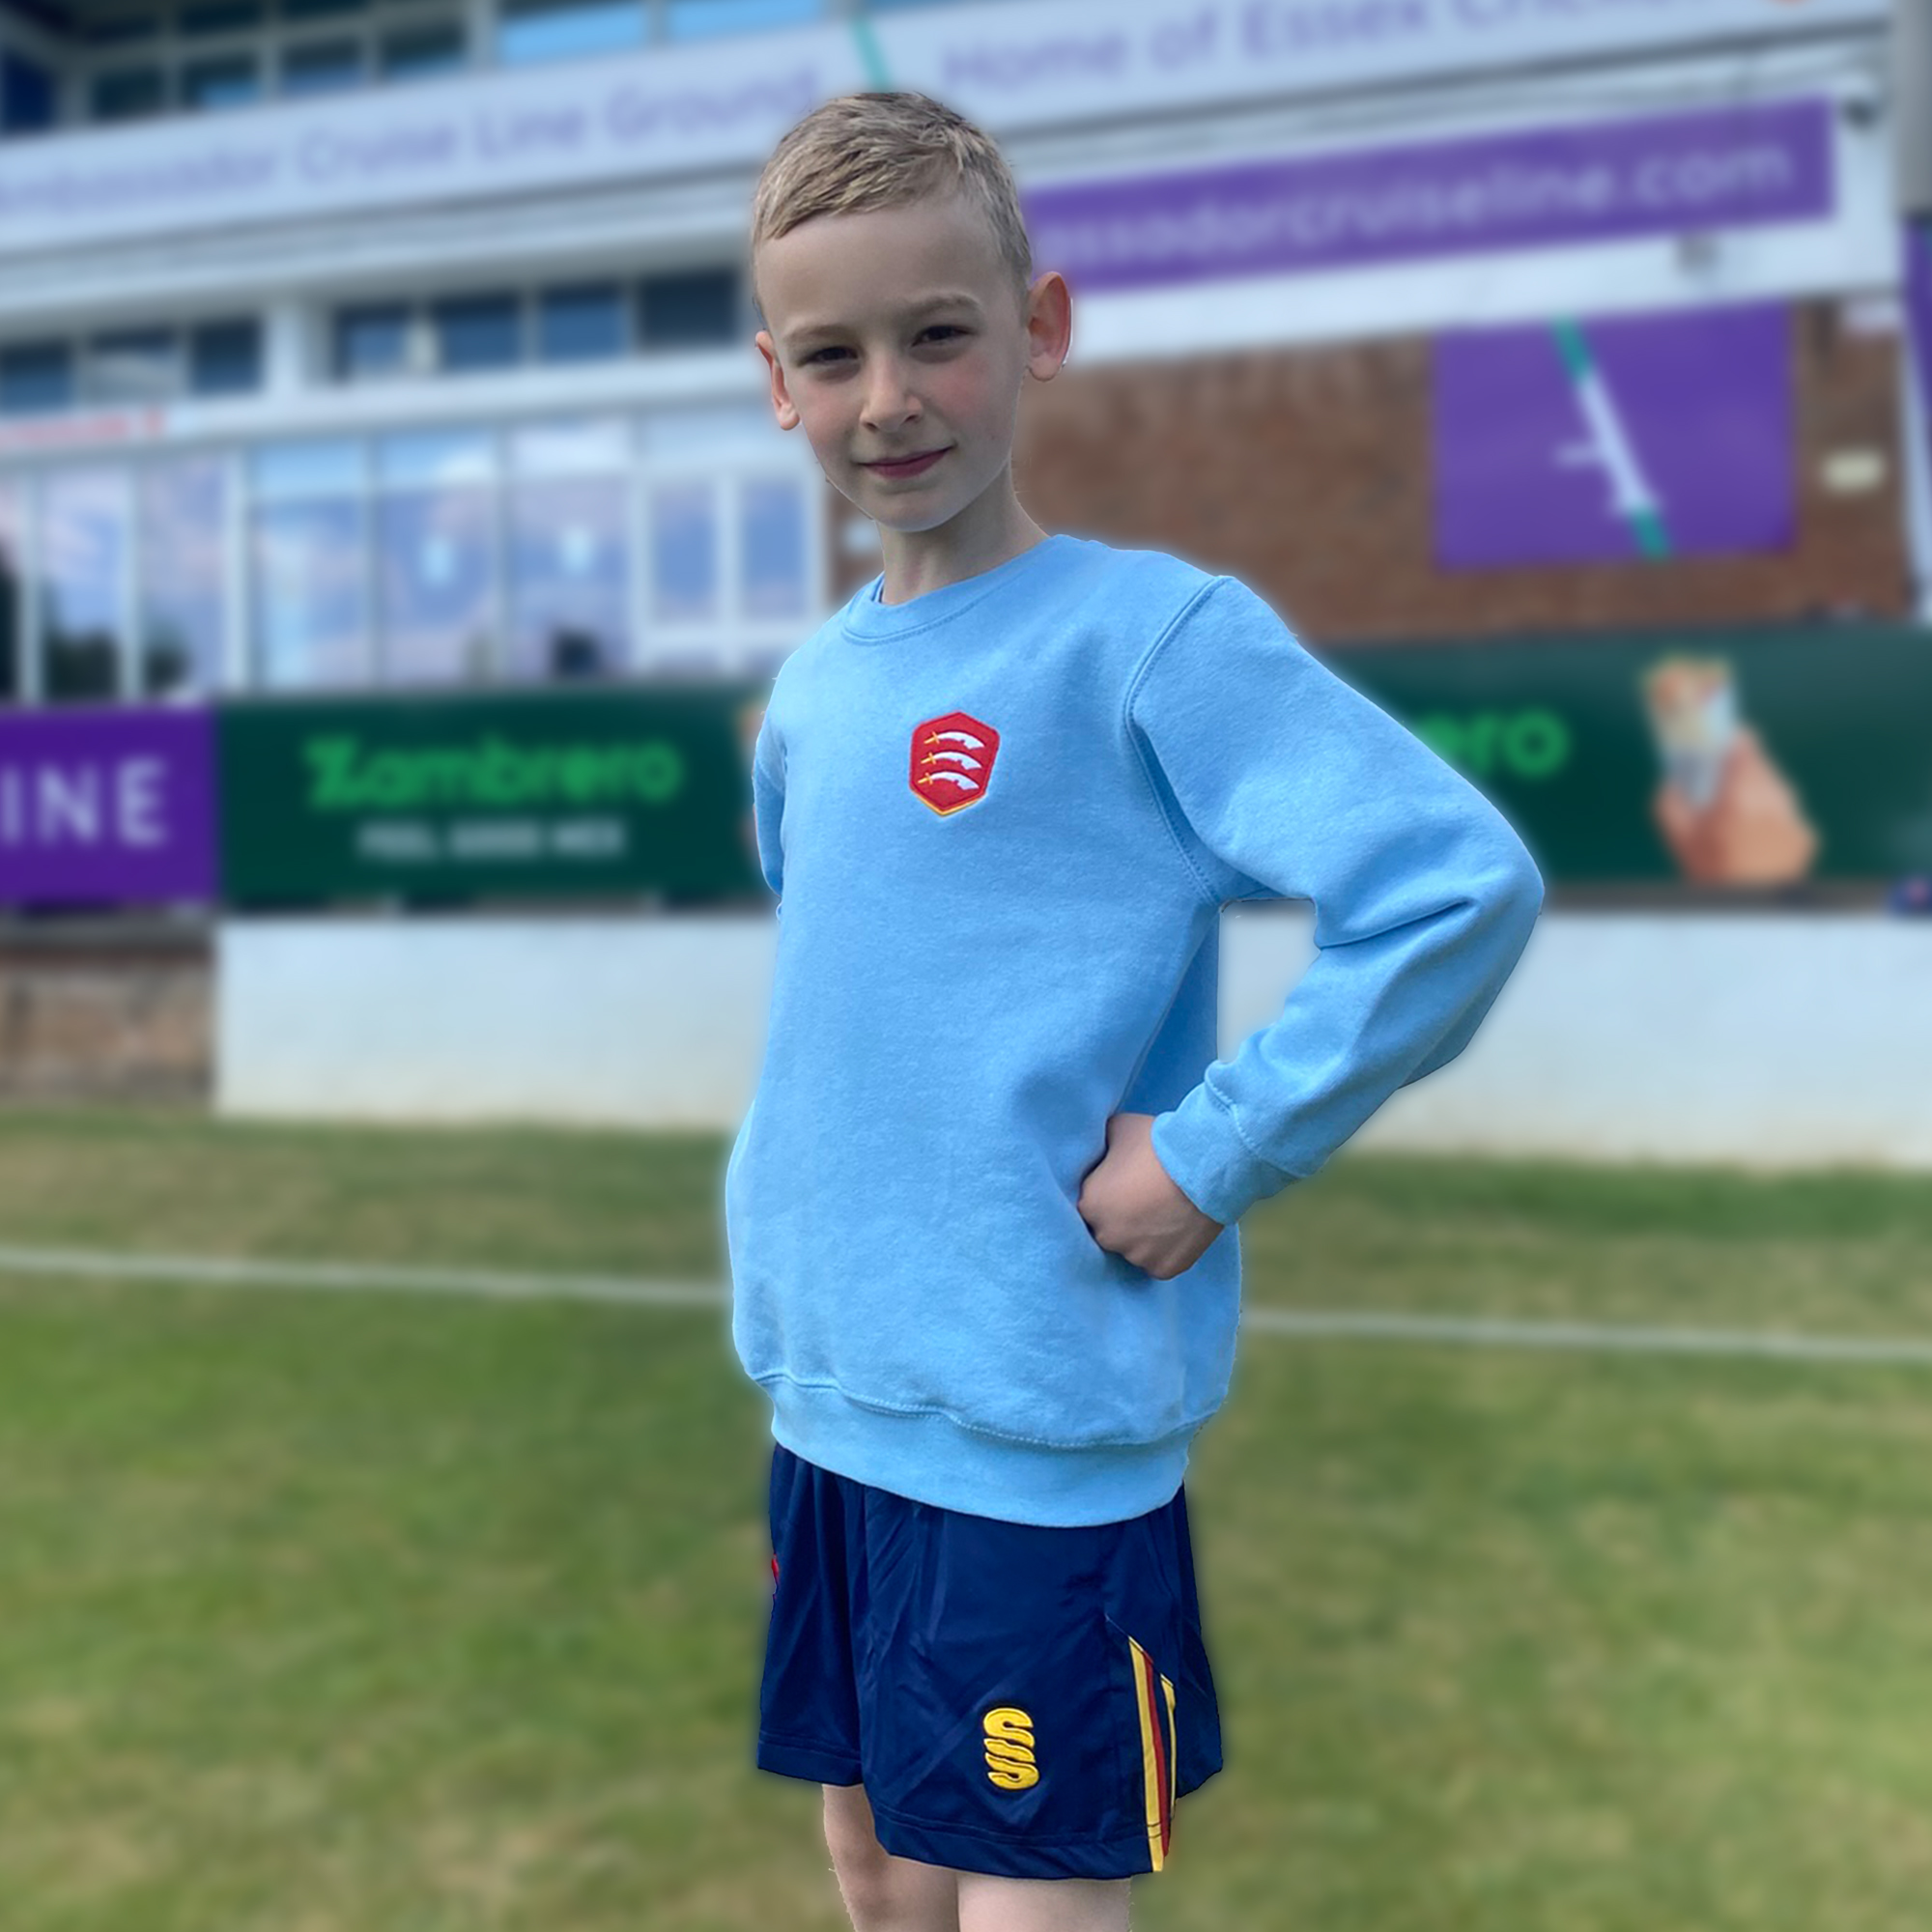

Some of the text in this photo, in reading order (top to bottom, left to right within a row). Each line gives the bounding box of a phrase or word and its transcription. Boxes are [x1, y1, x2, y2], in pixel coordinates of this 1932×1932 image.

[942, 31, 1128, 91] Home
[1147, 6, 1218, 71] of
[474, 102, 586, 160] Line
[604, 66, 820, 143] Ground
[302, 732, 683, 810] Zambrero
